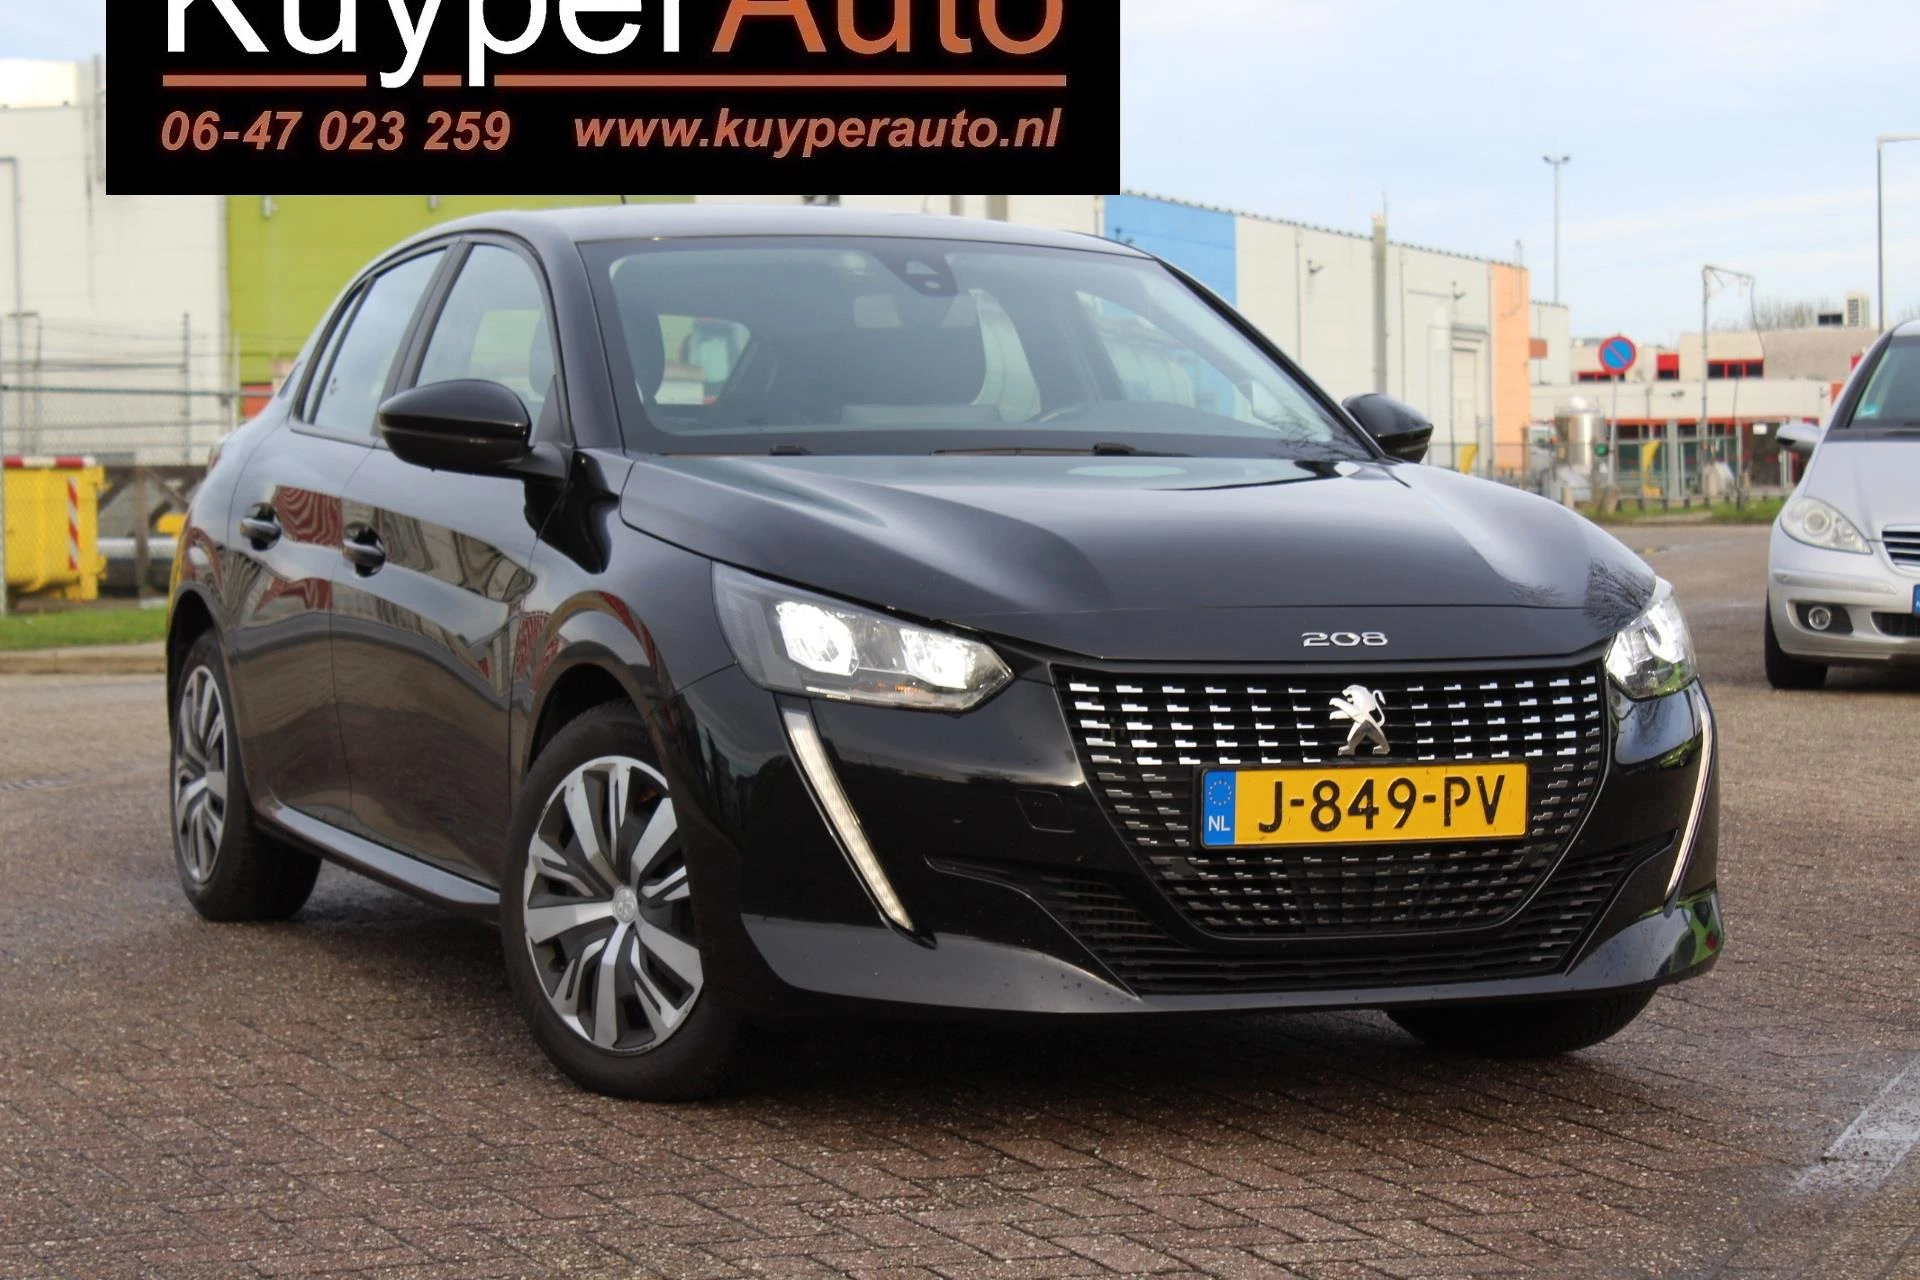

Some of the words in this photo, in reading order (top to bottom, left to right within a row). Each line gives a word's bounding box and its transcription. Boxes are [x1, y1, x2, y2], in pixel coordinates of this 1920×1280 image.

[1301, 631, 1388, 648] 208
[1258, 774, 1506, 834] J-849-PV
[1208, 815, 1231, 833] NL
